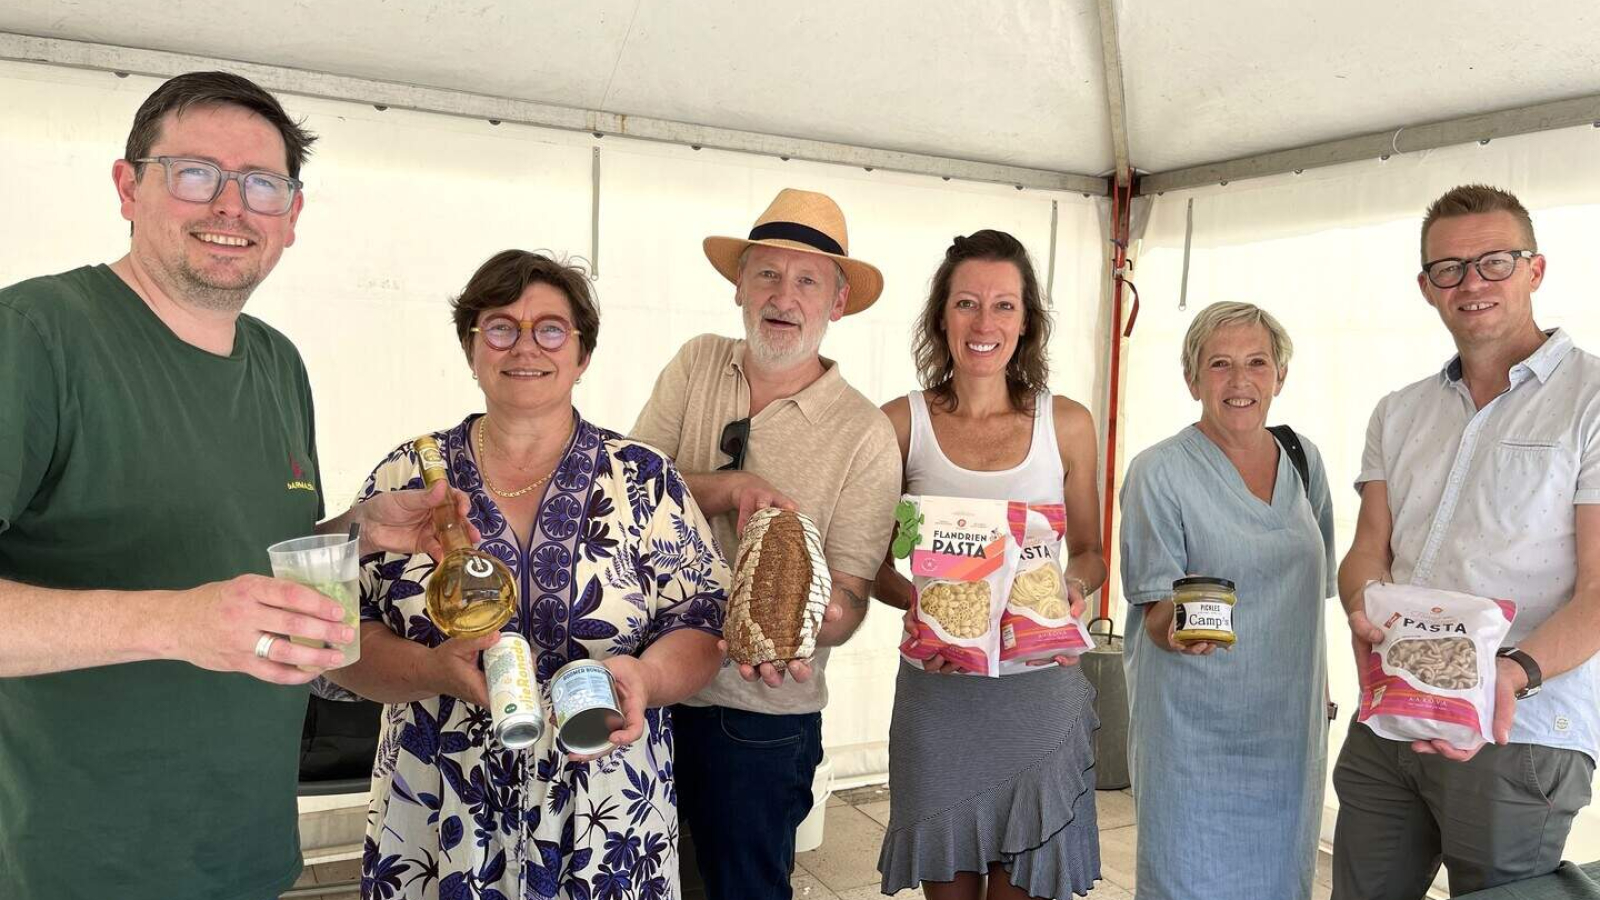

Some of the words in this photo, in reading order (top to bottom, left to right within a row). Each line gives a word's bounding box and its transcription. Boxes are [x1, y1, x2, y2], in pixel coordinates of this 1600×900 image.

[933, 530, 988, 542] FLANDRIEN
[932, 539, 987, 559] PASTA
[1189, 614, 1229, 629] Camp's
[1403, 617, 1467, 634] PASTA
